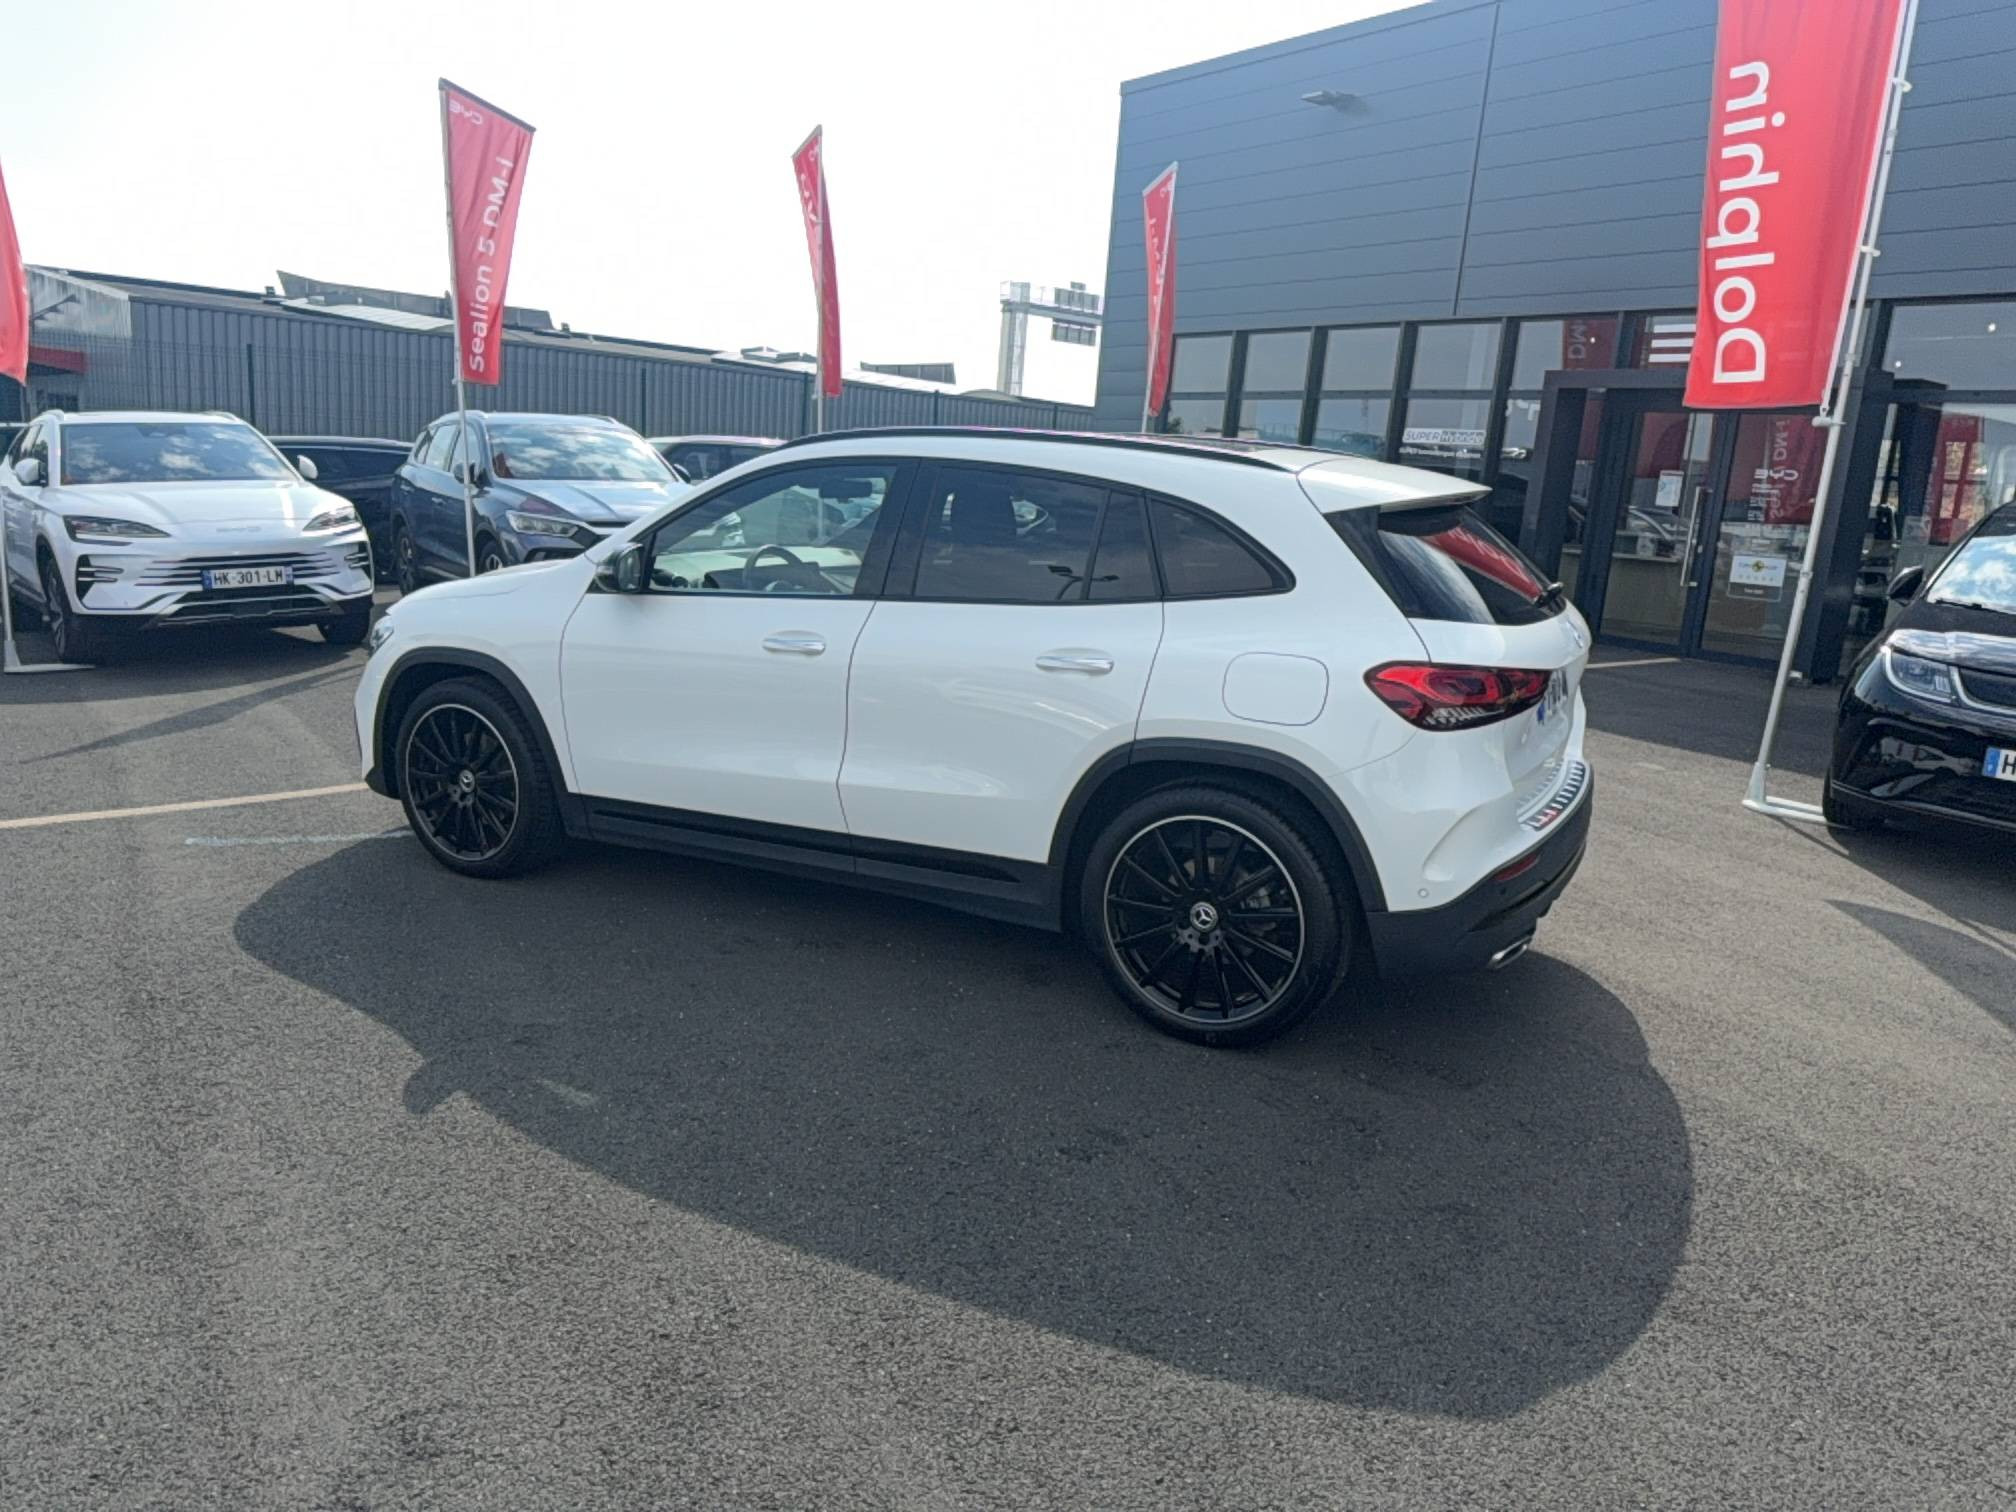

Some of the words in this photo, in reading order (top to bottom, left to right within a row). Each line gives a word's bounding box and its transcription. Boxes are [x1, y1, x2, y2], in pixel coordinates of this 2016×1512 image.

[483, 156, 515, 229] DM-i
[478, 235, 496, 257] 5
[1405, 430, 1440, 441] SUPER
